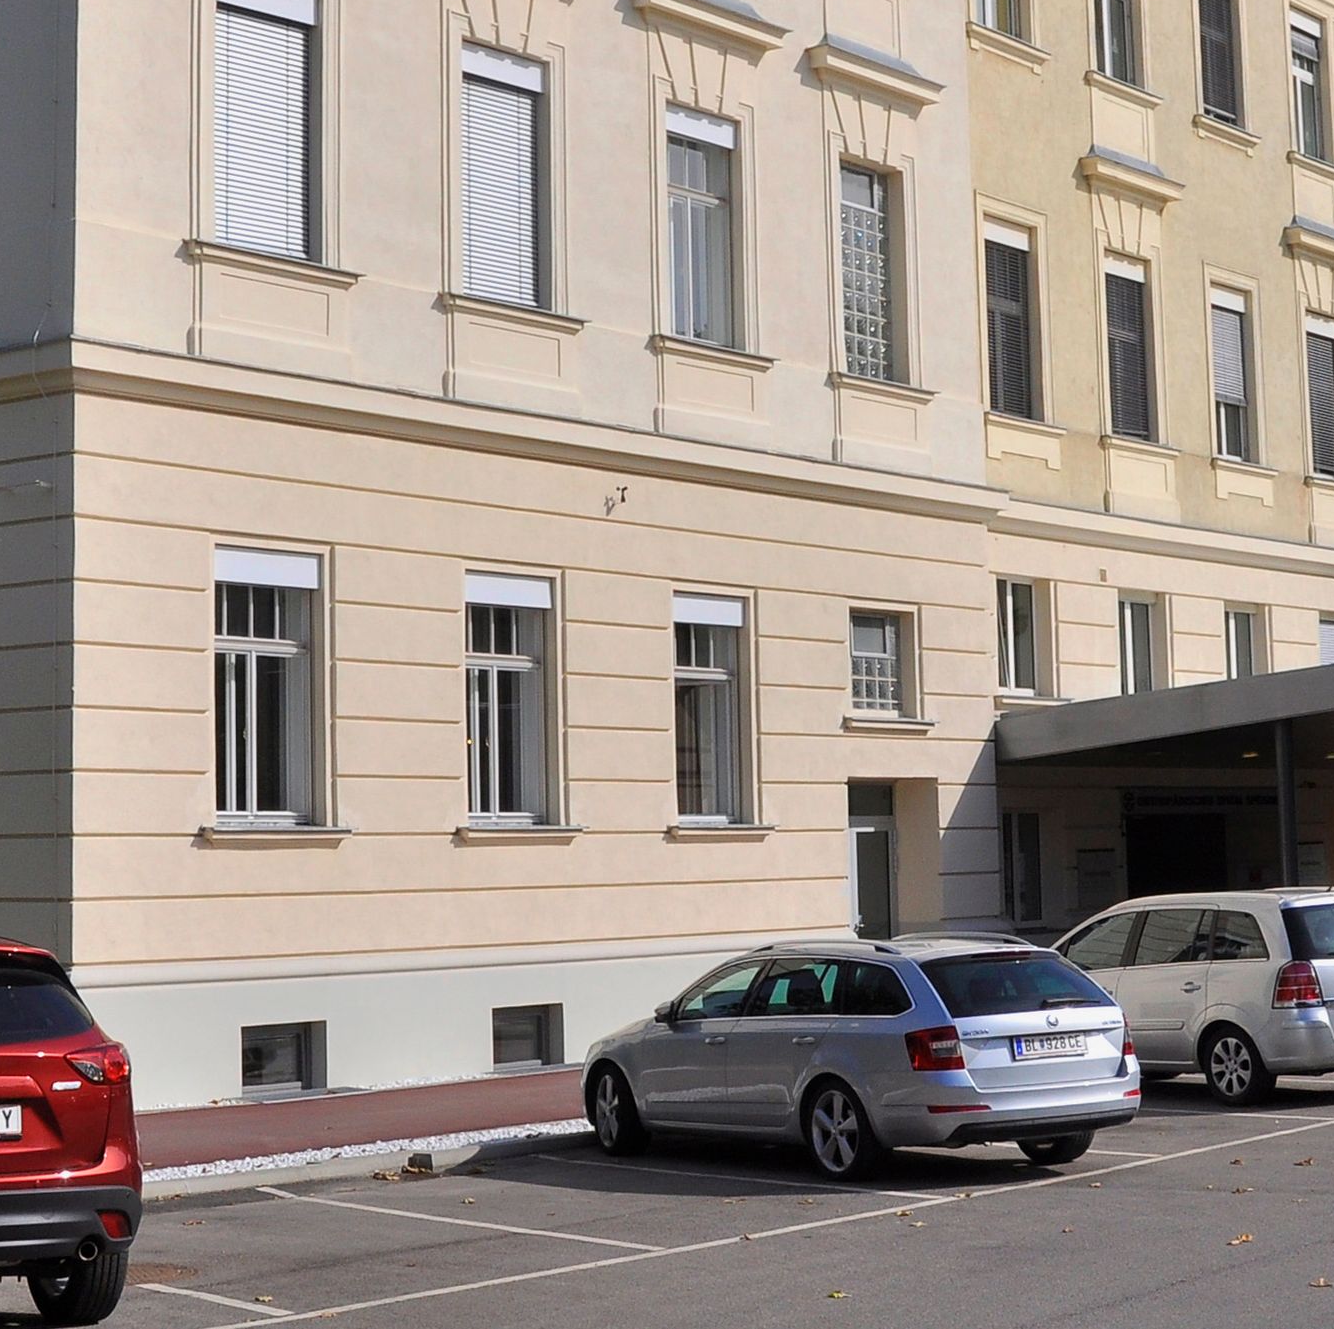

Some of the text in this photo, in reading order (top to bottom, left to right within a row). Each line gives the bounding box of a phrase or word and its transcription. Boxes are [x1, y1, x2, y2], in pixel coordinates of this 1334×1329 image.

[1024, 1034, 1083, 1052] BL 928 CE
